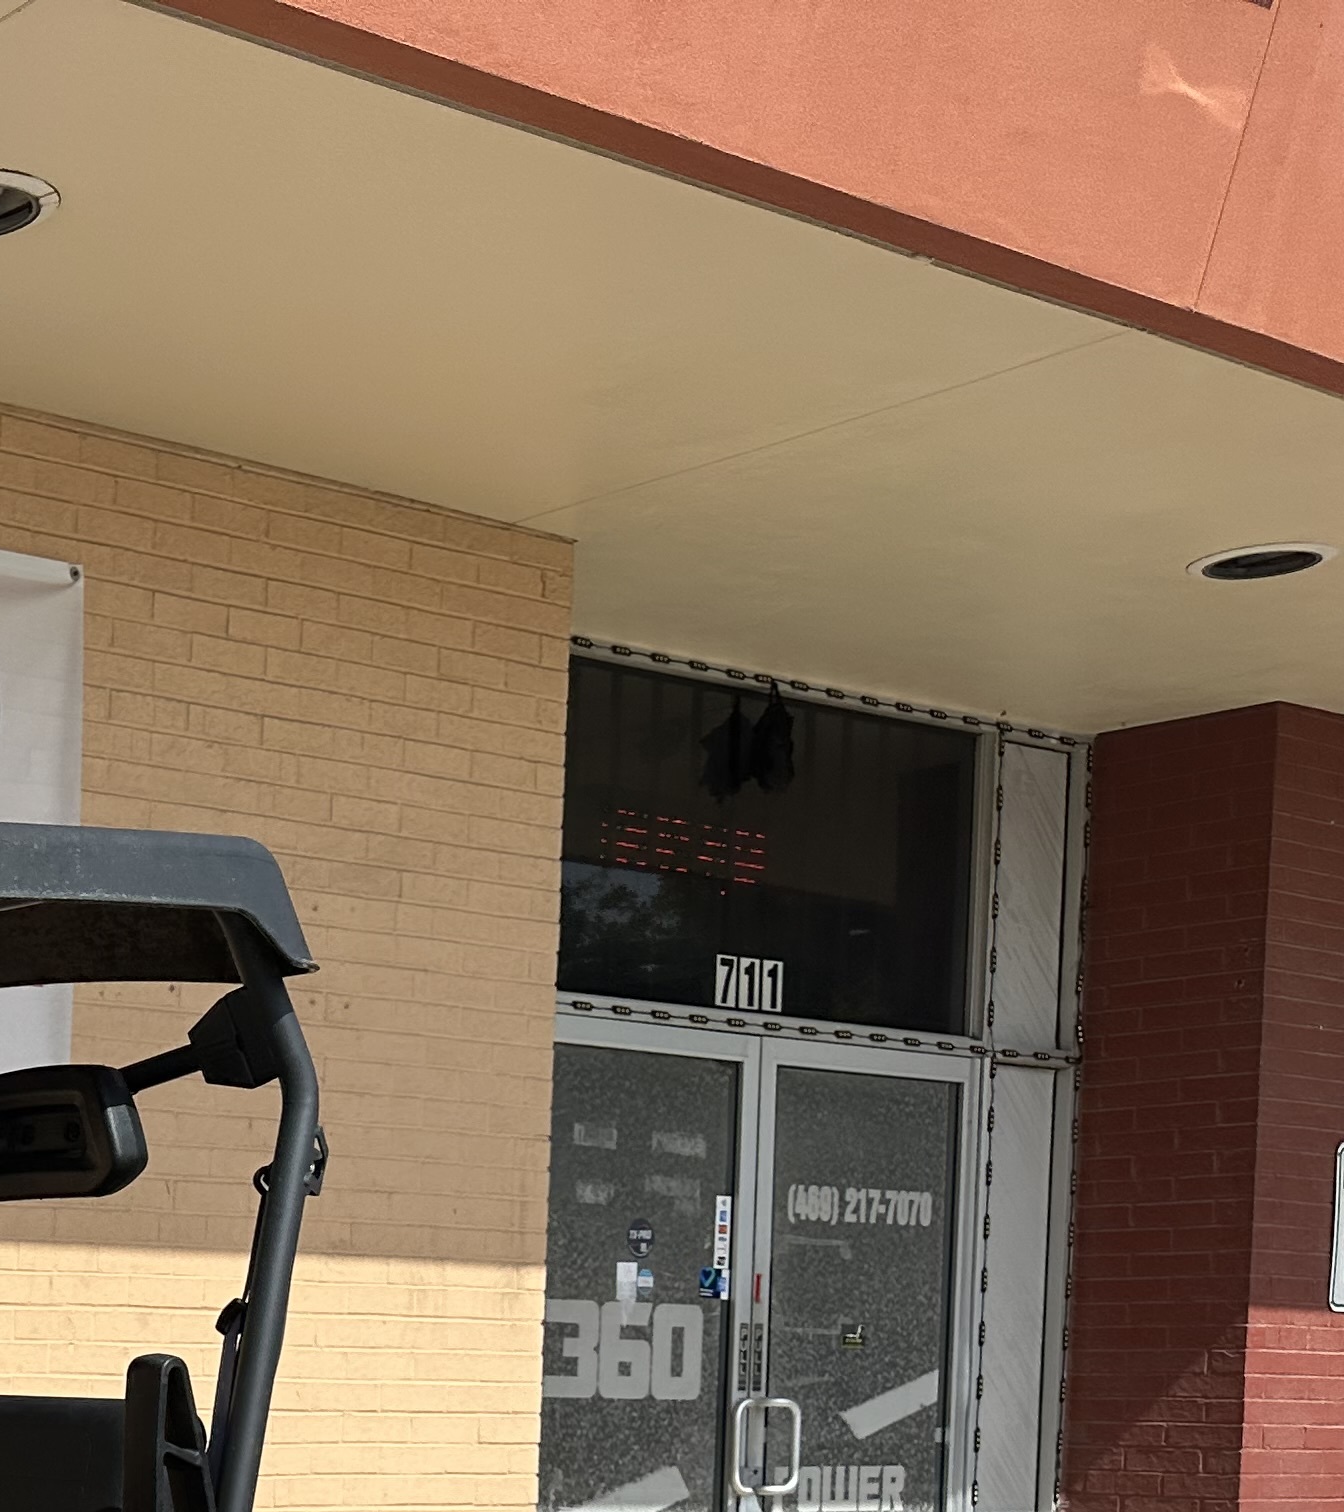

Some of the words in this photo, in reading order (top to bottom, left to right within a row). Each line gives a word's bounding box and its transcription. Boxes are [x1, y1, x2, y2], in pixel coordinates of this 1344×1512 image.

[717, 956, 781, 1012] 711
[844, 1187, 933, 1227] 217-7070
[545, 1298, 703, 1400] 360
